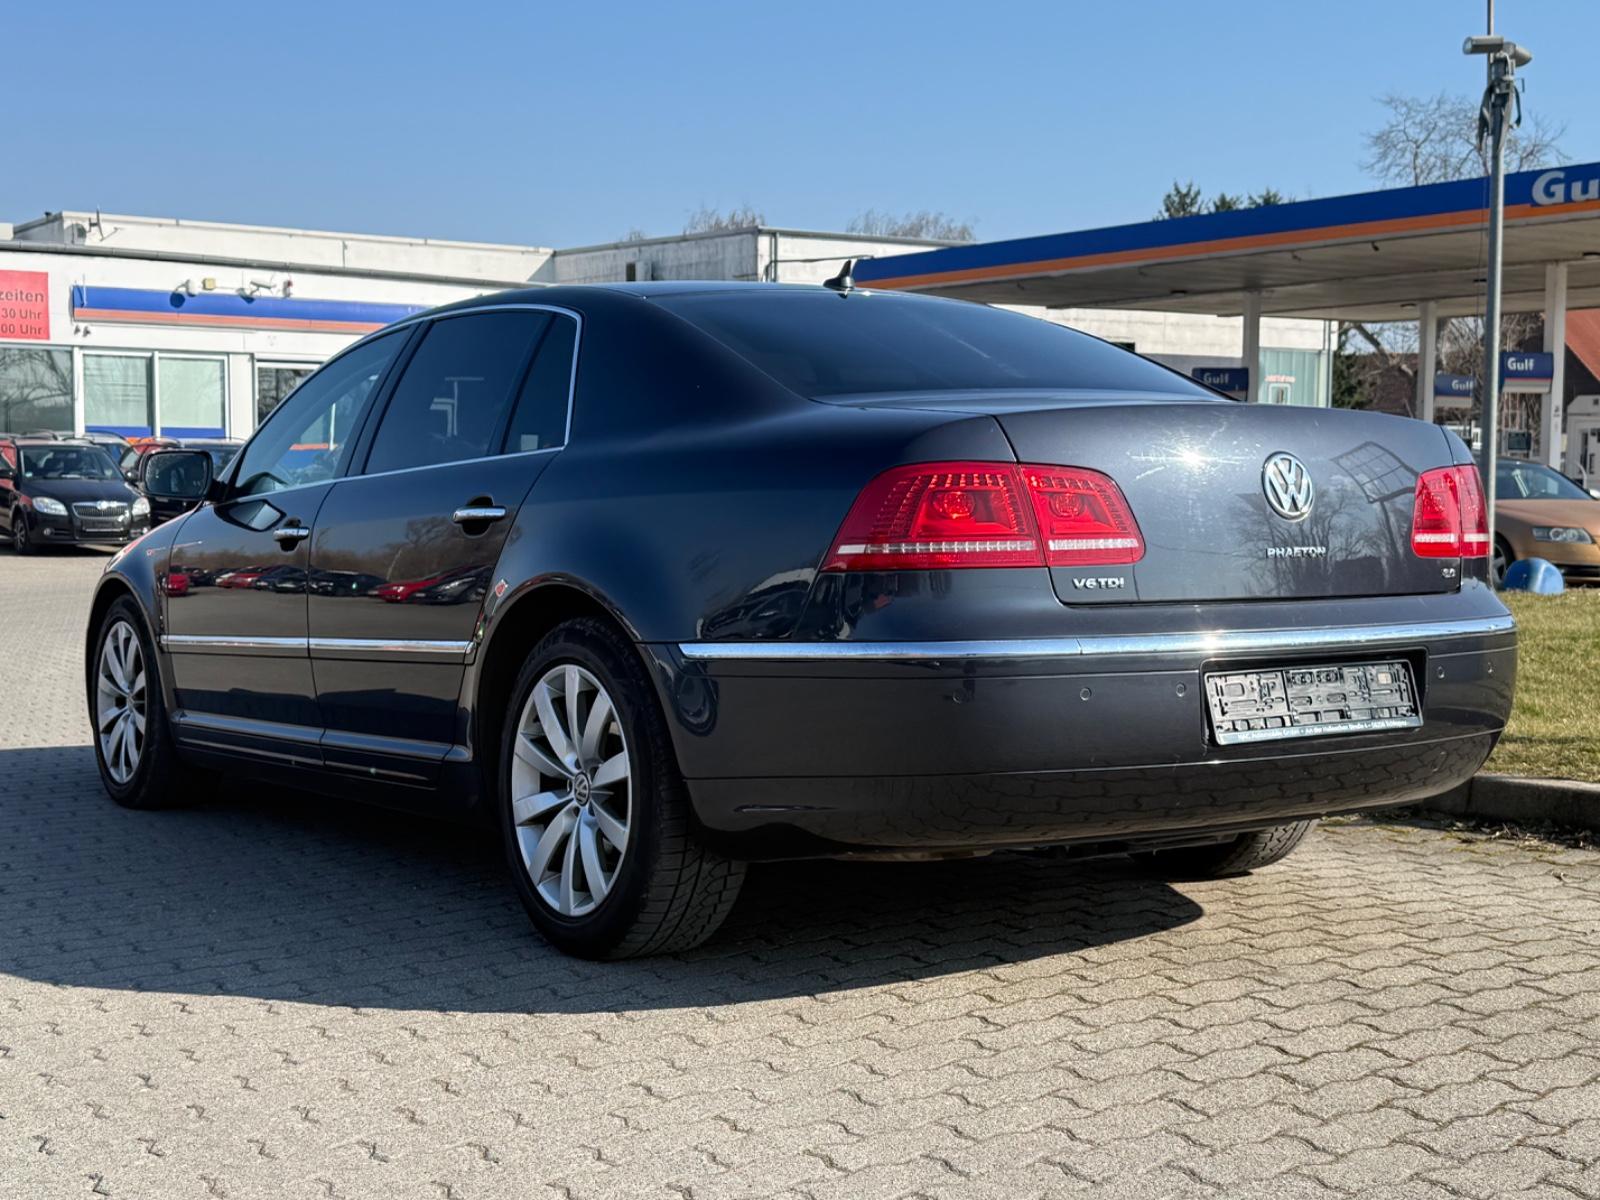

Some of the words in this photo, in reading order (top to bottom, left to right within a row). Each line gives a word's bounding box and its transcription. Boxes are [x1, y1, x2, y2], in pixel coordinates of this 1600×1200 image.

[20, 309, 42, 320] Uhr
[1, 323, 15, 334] 00
[20, 324, 42, 335] Uhr
[1507, 357, 1534, 371] Gulf
[1203, 372, 1229, 385] Gulf
[1451, 379, 1475, 391] Gulf
[1266, 546, 1327, 558] PHAETON
[1072, 577, 1097, 590] V6
[1097, 577, 1125, 590] TDI
